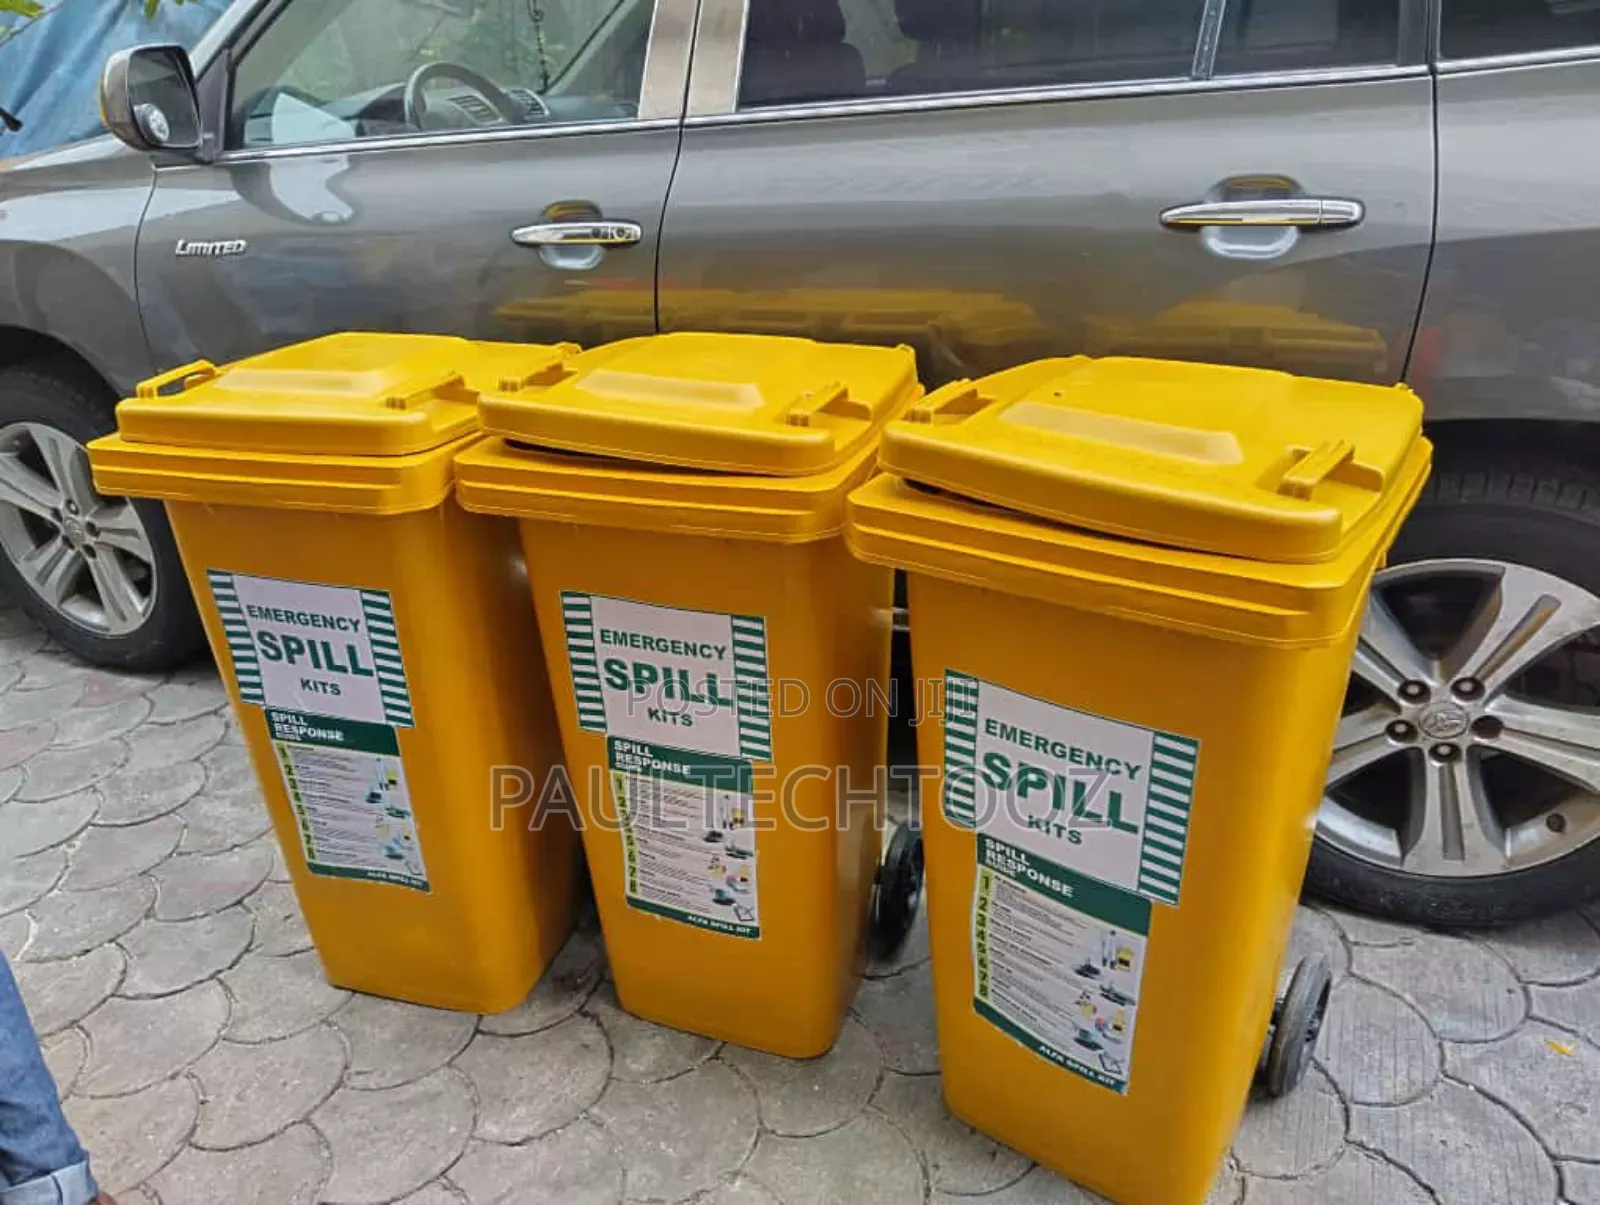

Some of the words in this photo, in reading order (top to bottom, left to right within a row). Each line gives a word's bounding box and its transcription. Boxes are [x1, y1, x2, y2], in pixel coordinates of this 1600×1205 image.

[246, 604, 360, 633] EMERGENCY
[257, 630, 374, 677] SPILL
[600, 628, 726, 661] EMERGENCY
[300, 678, 341, 696] KITS
[603, 657, 734, 707] SPILL
[271, 711, 308, 726] SPILL
[648, 707, 693, 727] KITS
[275, 723, 344, 741] RESPONSE
[615, 740, 653, 758] SPILL
[616, 752, 691, 775] RESPONSE
[984, 718, 1142, 780] EMERGENCY
[983, 751, 1139, 835] SPILL
[1027, 815, 1083, 845] KITS
[985, 838, 1030, 867] SPILL
[985, 849, 1074, 898] RESPONSE
